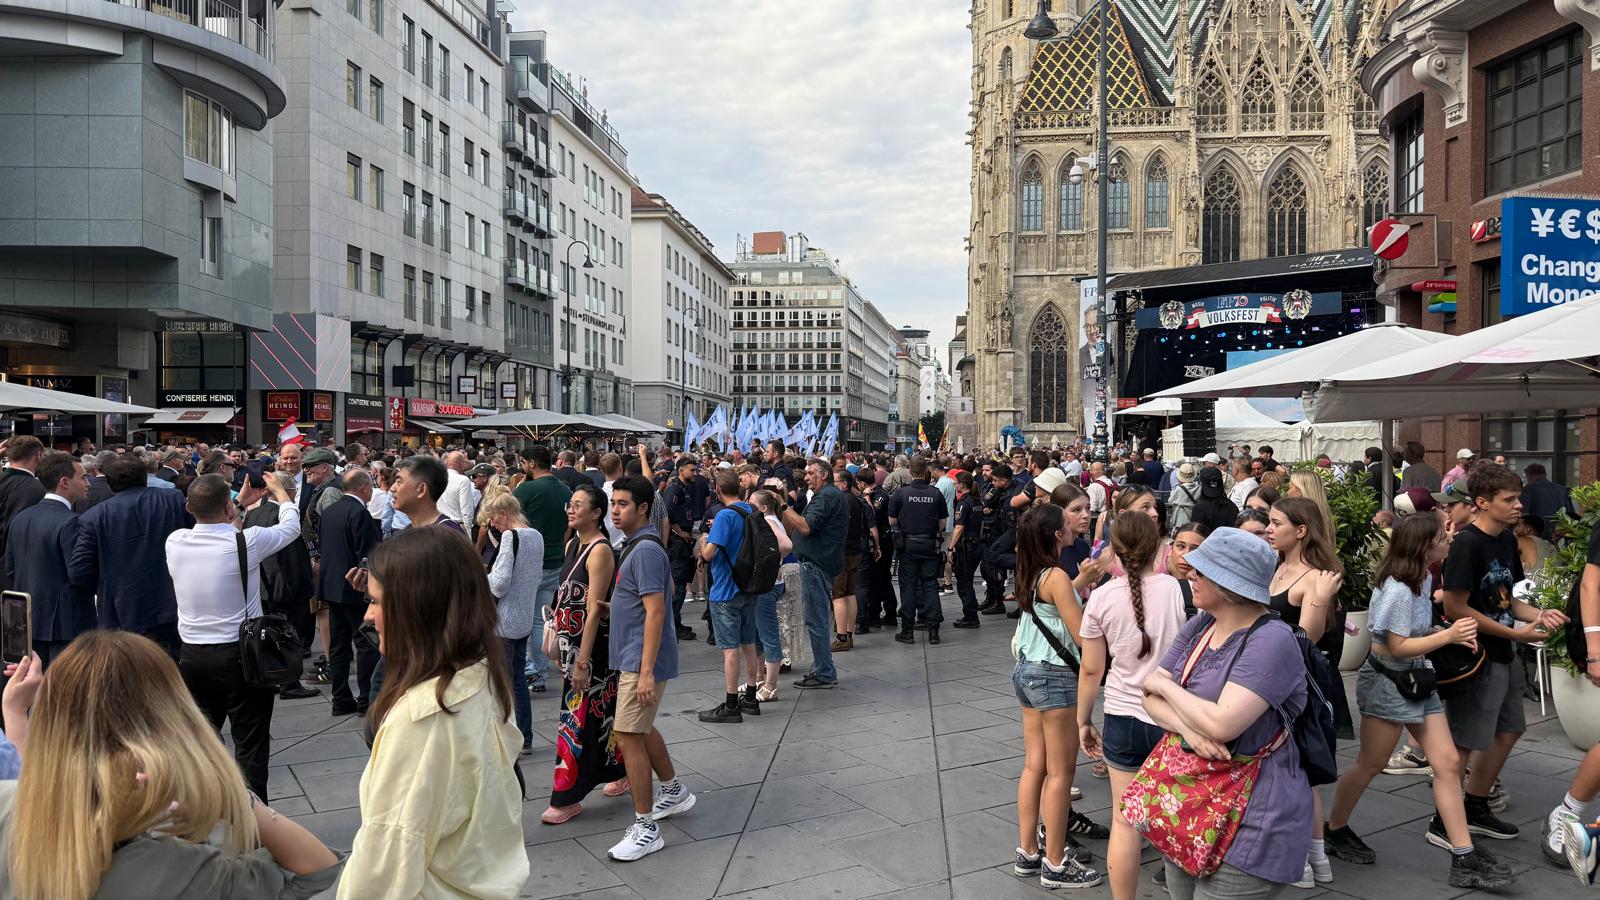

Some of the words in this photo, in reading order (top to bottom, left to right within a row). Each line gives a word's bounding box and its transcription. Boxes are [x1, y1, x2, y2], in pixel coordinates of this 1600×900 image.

[1289, 256, 1364, 269] MAINSTAGE
[563, 306, 577, 318] HTEL
[1207, 309, 1259, 324] VOLKSFEST
[165, 394, 207, 402] CONFISERIE
[210, 394, 234, 402] HEINDL
[438, 403, 475, 416] SOUVENIRS
